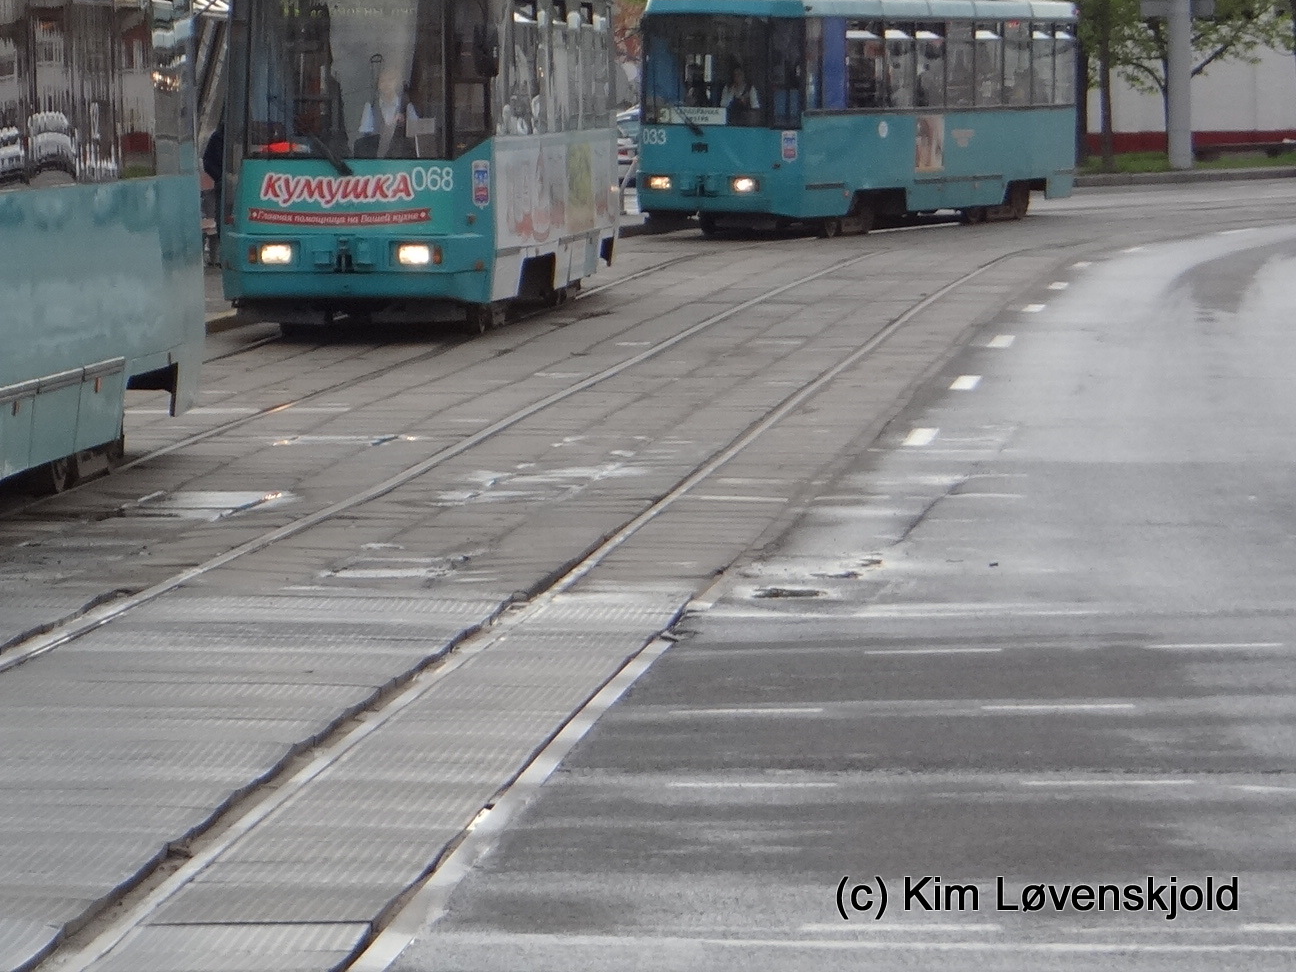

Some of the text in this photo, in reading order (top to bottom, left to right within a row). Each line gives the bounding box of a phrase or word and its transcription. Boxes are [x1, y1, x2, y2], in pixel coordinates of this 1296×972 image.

[643, 129, 667, 145] 033
[260, 173, 415, 208] КУМУШКА
[411, 166, 454, 192] 068
